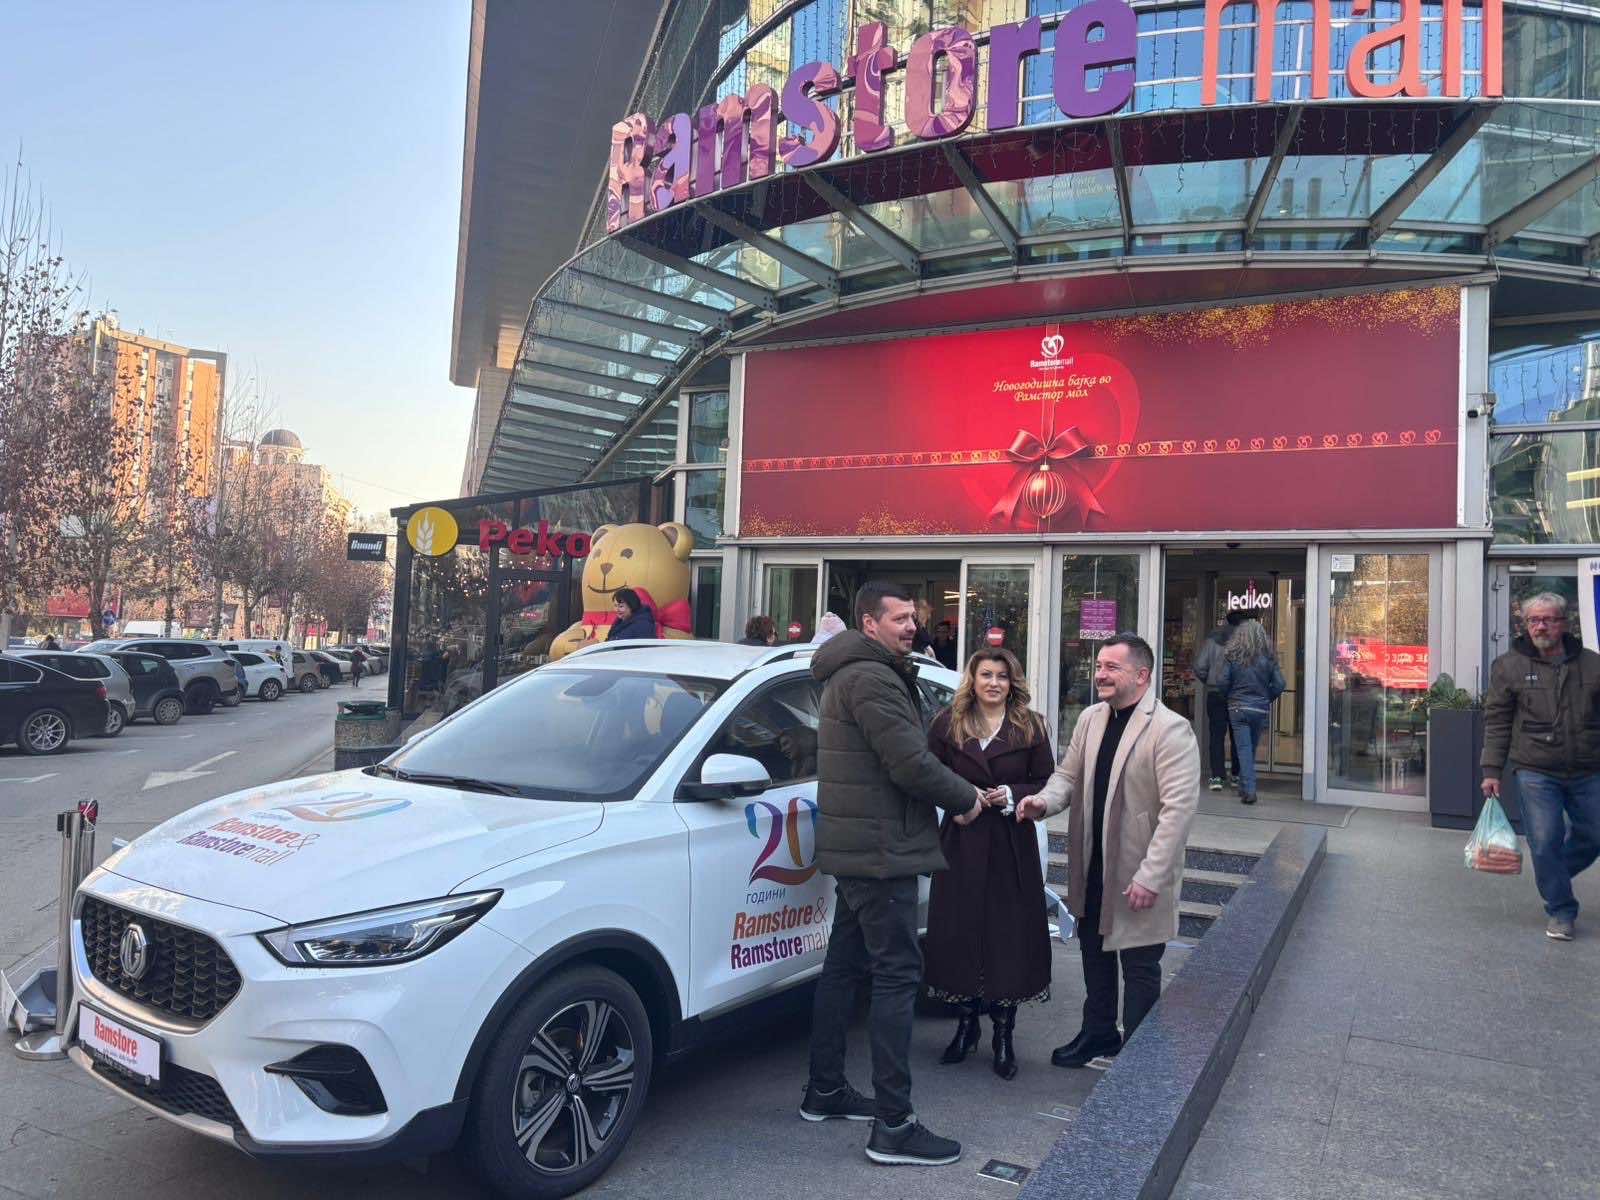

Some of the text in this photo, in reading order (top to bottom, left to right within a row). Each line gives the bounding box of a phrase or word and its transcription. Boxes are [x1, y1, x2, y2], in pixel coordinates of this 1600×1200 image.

[606, 0, 1504, 233] Ramstore mall
[993, 373, 1112, 392] Новогодишна бајка во
[1014, 389, 1089, 402] Рамстор мол
[744, 796, 818, 888] 20
[745, 886, 787, 905] години
[94, 1015, 138, 1057] Ramstore
